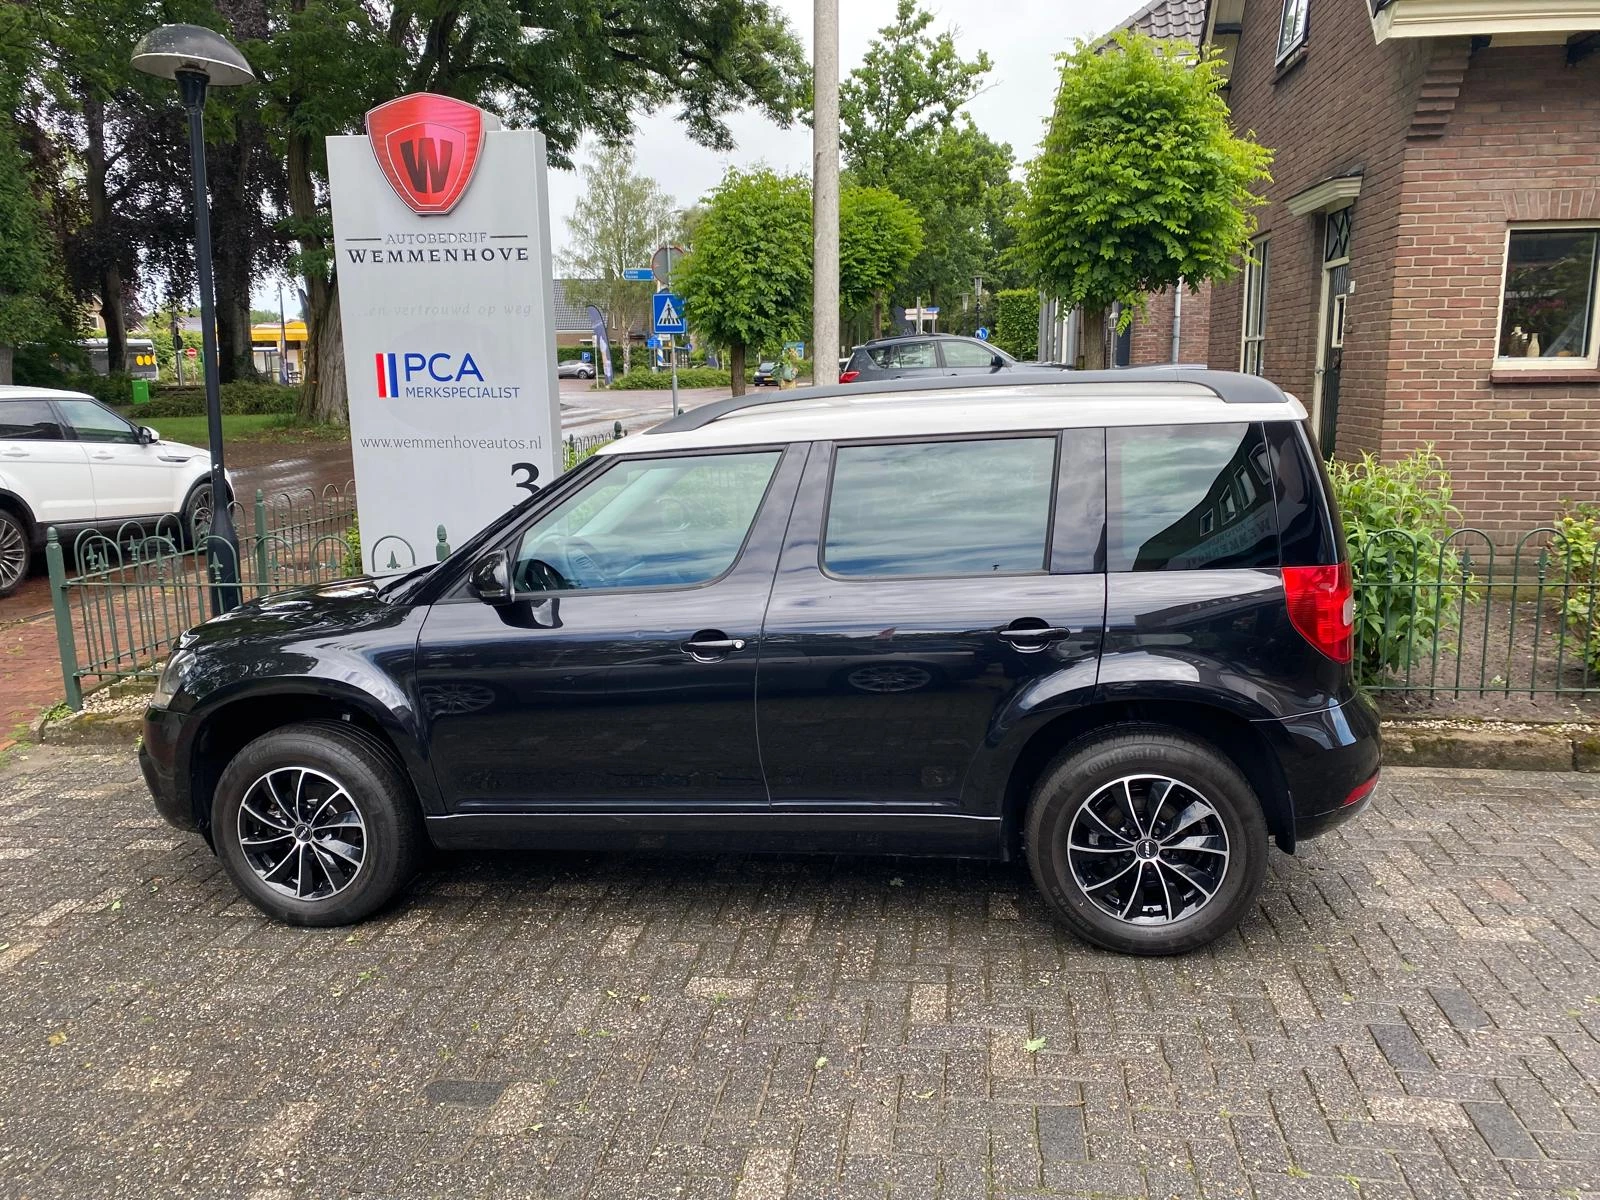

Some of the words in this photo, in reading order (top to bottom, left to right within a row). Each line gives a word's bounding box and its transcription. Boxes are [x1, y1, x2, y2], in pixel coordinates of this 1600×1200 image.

[400, 137, 453, 194] W
[385, 232, 487, 245] AUTOBEDRIJF
[345, 248, 529, 264] WEMMENHOVE
[394, 303, 471, 317] vertrouwd
[478, 305, 496, 317] op
[504, 303, 532, 318] weg
[404, 352, 485, 382] PCA
[405, 386, 521, 399] MERKSPECIALIST
[360, 435, 542, 450] www.wemmenhoveautos.nl
[511, 462, 541, 508] 3
